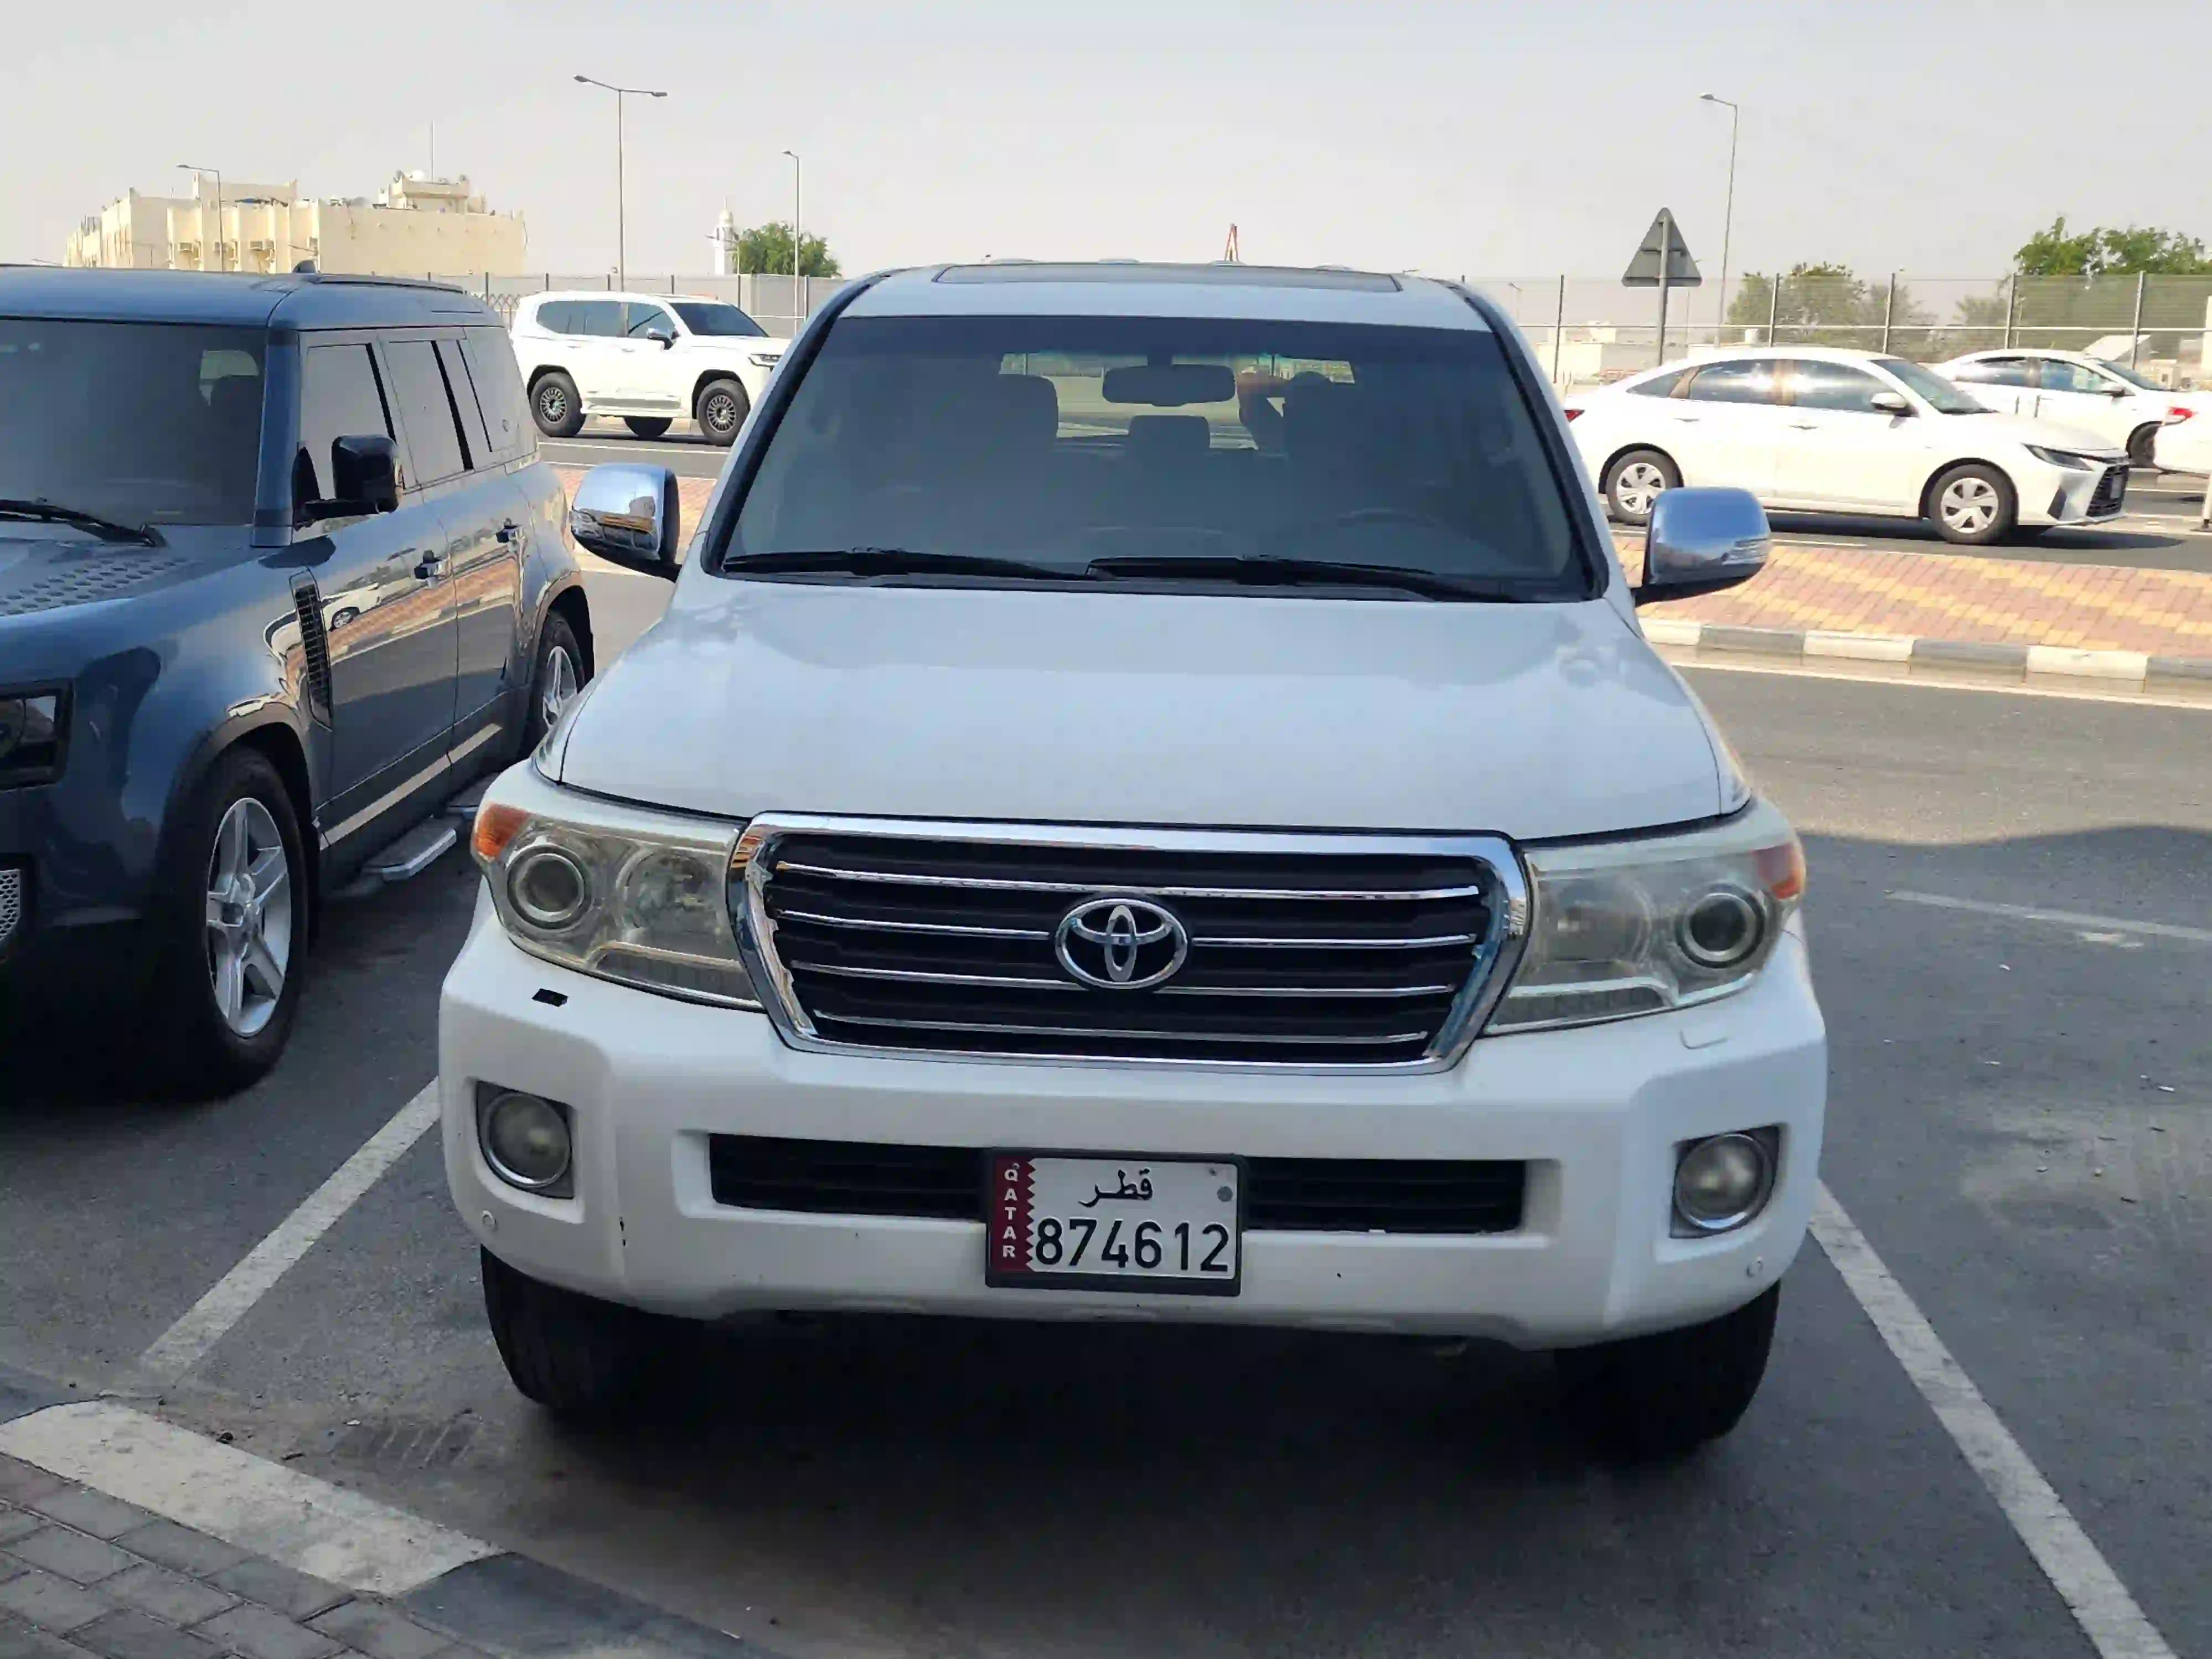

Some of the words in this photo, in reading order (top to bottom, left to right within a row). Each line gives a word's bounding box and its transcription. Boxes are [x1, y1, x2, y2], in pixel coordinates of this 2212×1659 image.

[1002, 1169, 1019, 1258] QATAR
[1078, 1168, 1153, 1208] قطر
[1035, 1218, 1229, 1272] 874612
